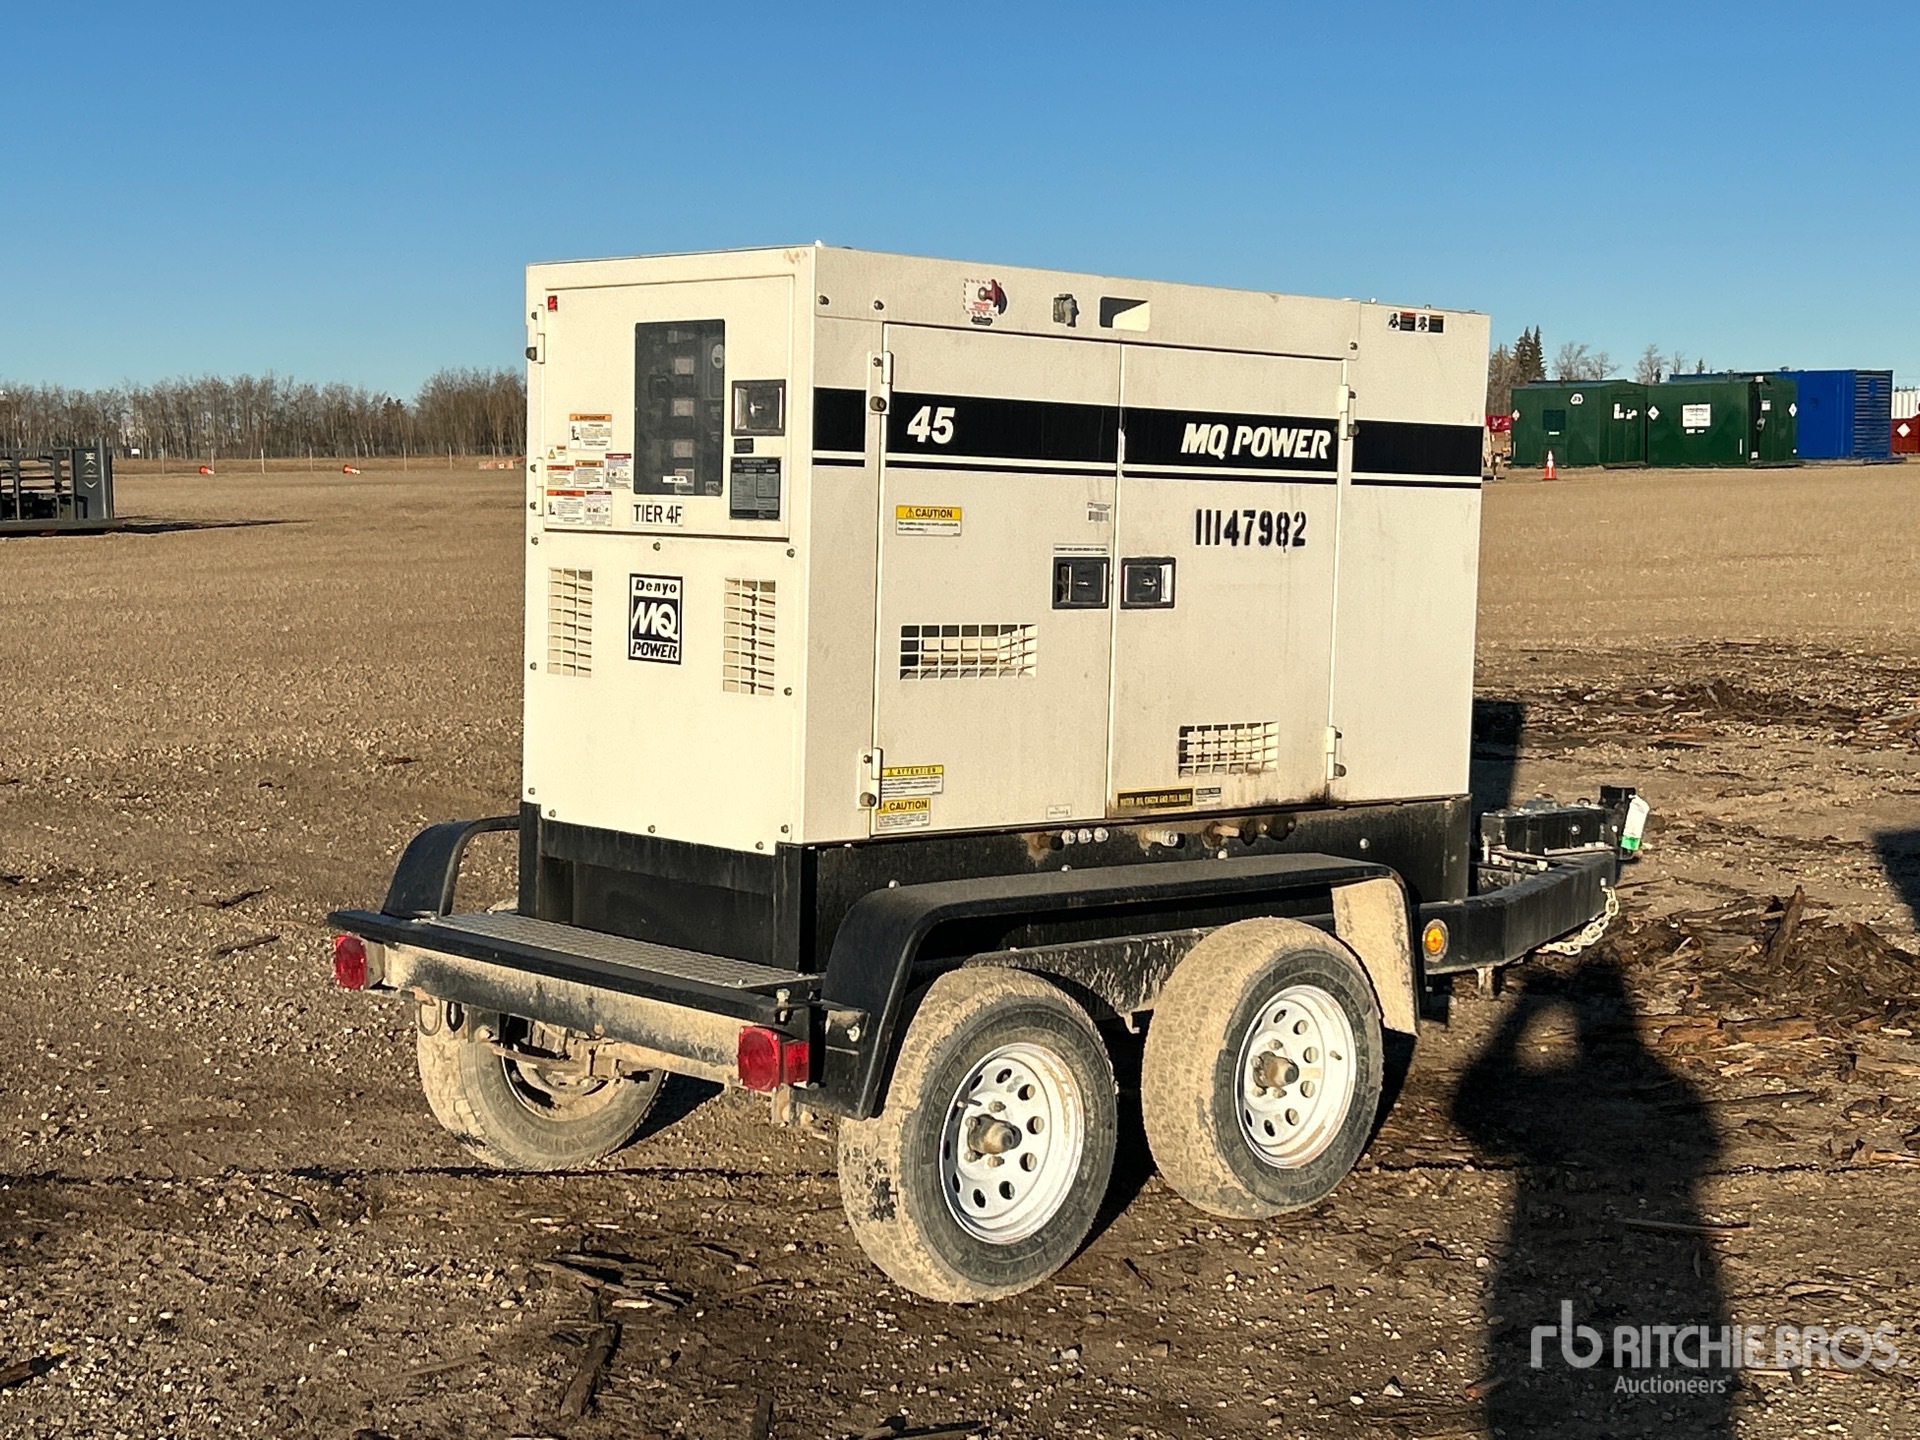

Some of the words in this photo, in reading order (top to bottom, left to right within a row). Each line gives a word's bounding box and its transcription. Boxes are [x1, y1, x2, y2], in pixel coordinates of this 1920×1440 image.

[907, 406, 955, 444] 45
[1181, 422, 1228, 460] MQ
[1234, 425, 1332, 460] POWER
[633, 504, 663, 524] TIER
[666, 505, 683, 525] 4F
[915, 508, 953, 519] CAUTION
[635, 579, 677, 595] Denyo
[632, 601, 678, 641] MQ
[632, 641, 678, 659] POWER
[889, 800, 927, 811] CAUTION
